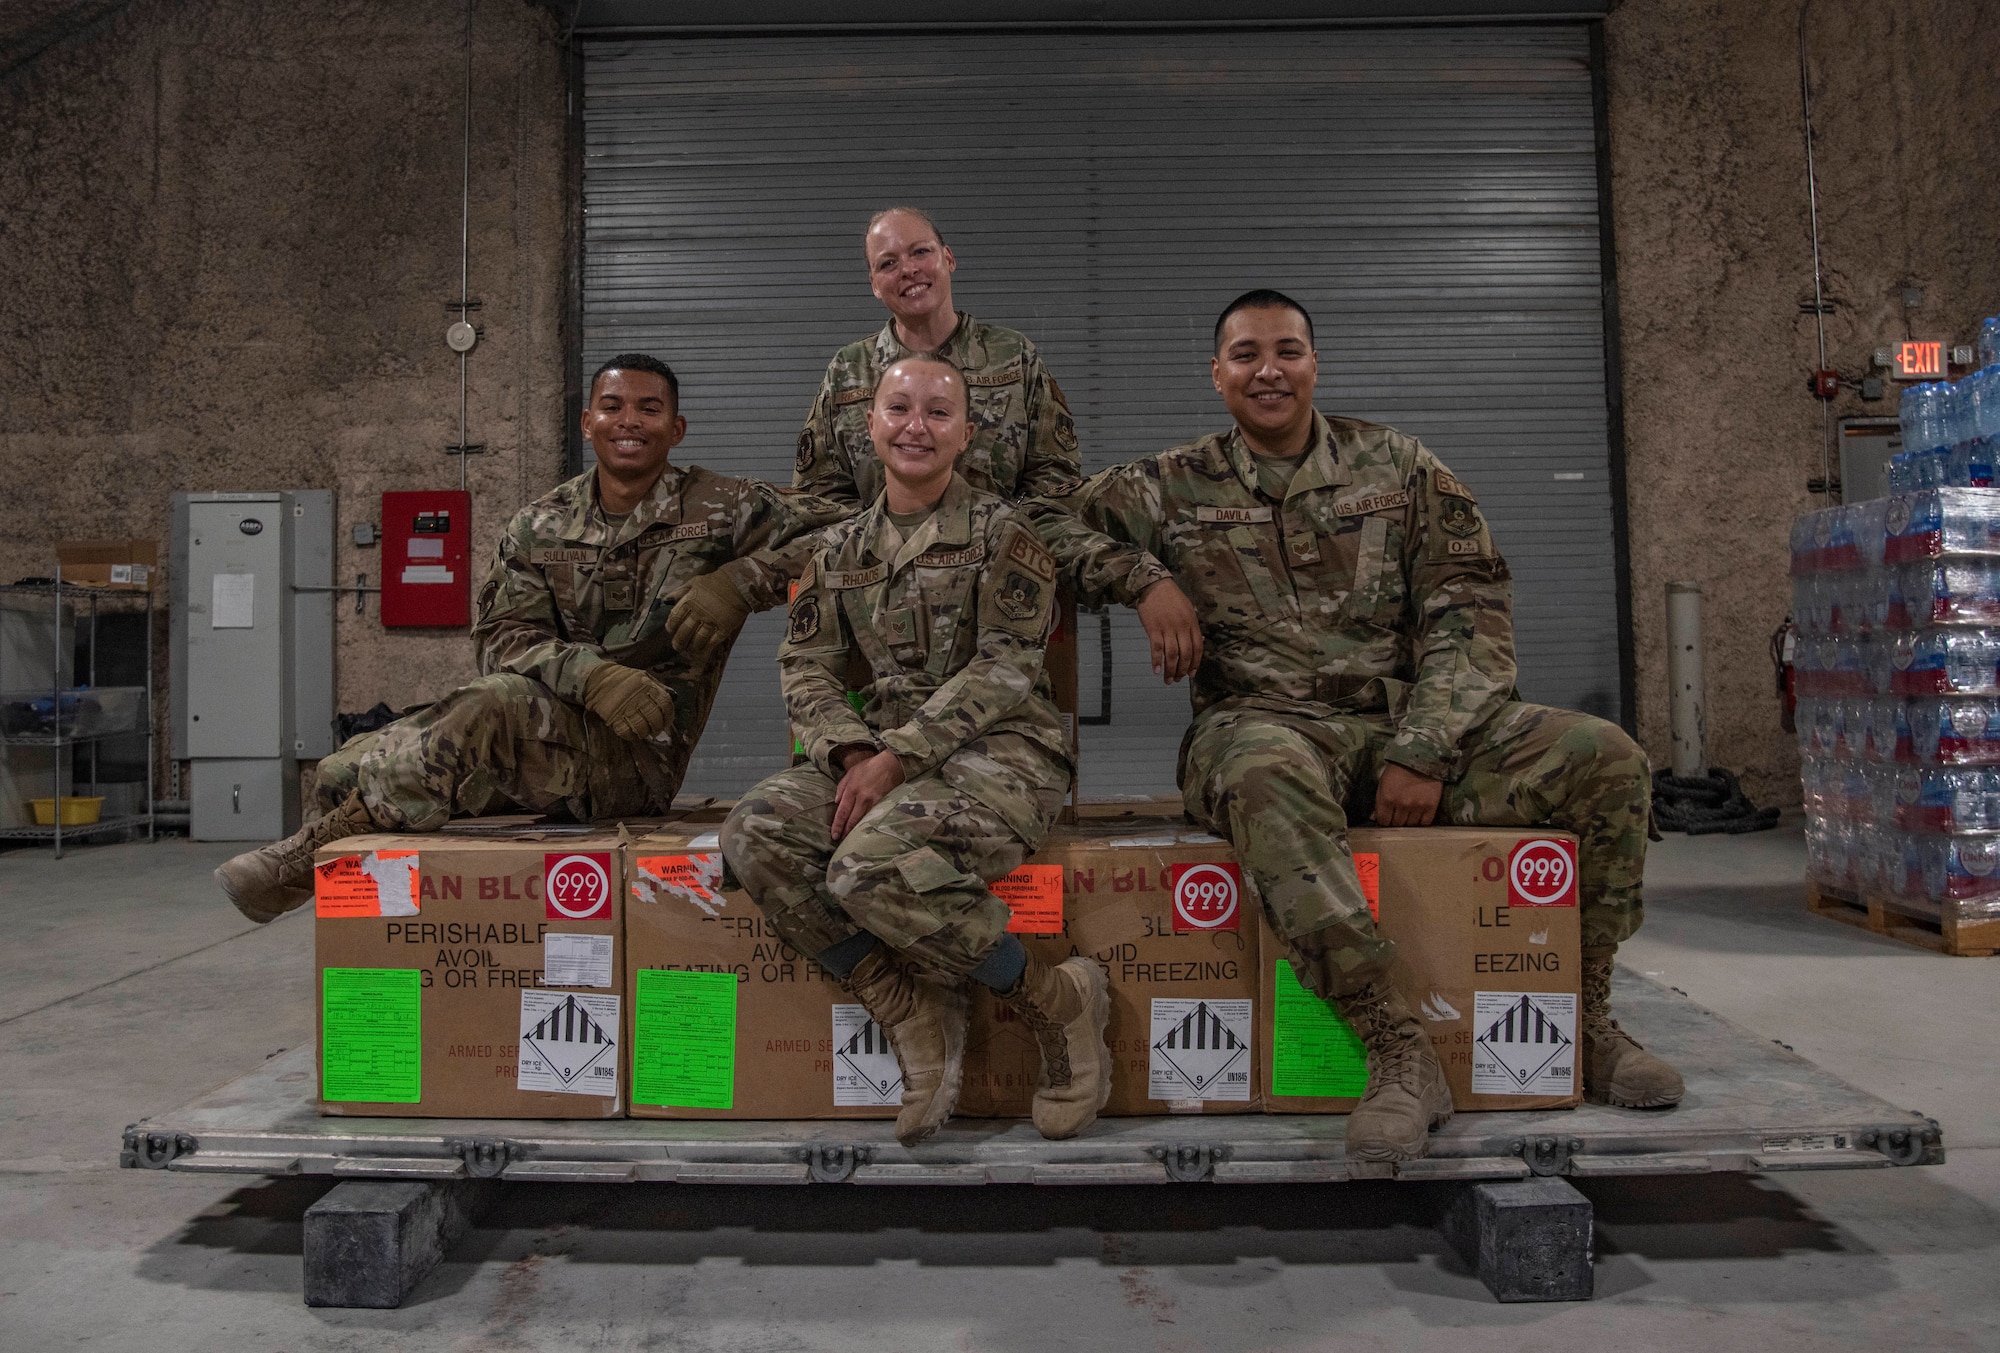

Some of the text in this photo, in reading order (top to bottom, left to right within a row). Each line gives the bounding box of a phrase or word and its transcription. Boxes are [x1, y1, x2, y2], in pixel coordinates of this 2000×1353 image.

[1902, 342, 1942, 374] EXIT
[977, 376, 991, 385] AIR
[992, 369, 1022, 385] FORCE
[1356, 499, 1372, 512] AIR
[1374, 492, 1407, 509] FORCE
[1216, 509, 1251, 521] DAVILA
[659, 530, 674, 542] AIR
[675, 524, 707, 539] FORCE
[938, 550, 957, 563] AIR
[958, 544, 983, 562] FORCE
[1012, 535, 1051, 574] BTC
[1451, 541, 1462, 552] O
[543, 551, 587, 563] SULLIVAN
[842, 569, 879, 586] RHOADS
[345, 860, 362, 869] WA
[1519, 857, 1564, 886] 999
[555, 872, 599, 902] 999
[1185, 882, 1229, 910] 999
[1474, 952, 1560, 974] EEZING
[445, 969, 477, 988] OR
[761, 964, 794, 983] OR
[1122, 961, 1238, 983] FREEZING
[448, 1045, 492, 1058] ARMED
[766, 1040, 832, 1052] ARMED SE
[1134, 1040, 1149, 1053] SE
[564, 1067, 571, 1077] 9
[1130, 1060, 1149, 1073] PR
[1519, 1068, 1526, 1079] 9
[880, 1079, 887, 1090] 9
[1196, 1075, 1203, 1084] 9
